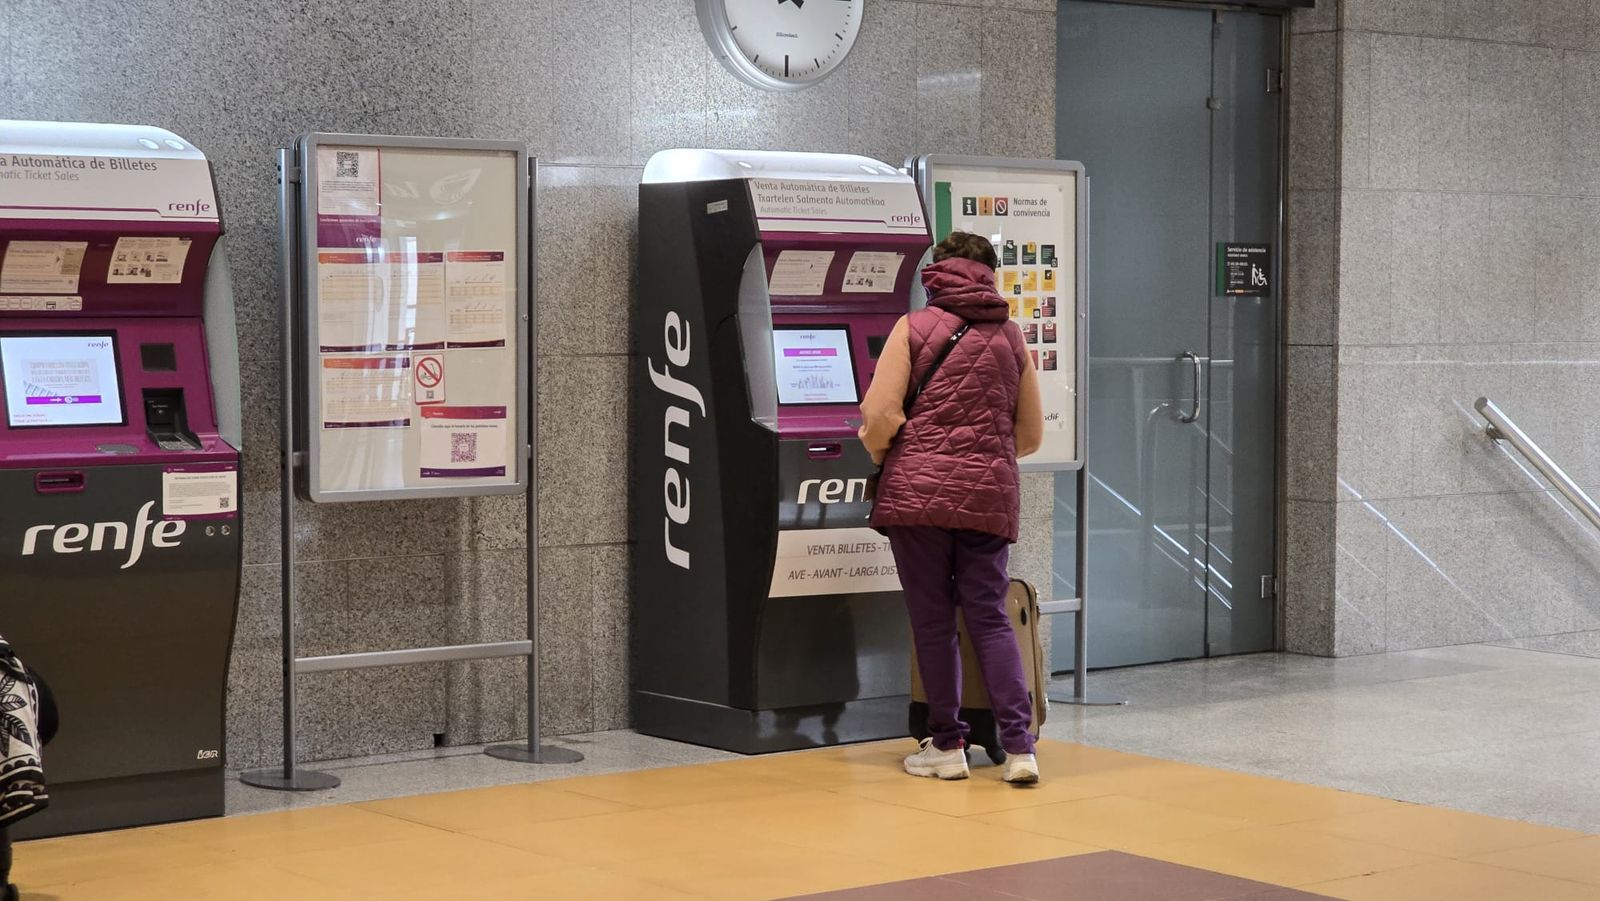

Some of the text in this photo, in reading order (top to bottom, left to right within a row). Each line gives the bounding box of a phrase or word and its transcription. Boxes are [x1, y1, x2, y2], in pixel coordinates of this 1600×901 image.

[12, 155, 86, 169] Automática
[90, 158, 106, 170] de
[110, 159, 158, 172] Billetes
[24, 169, 51, 181] Ticket
[55, 171, 80, 182] Sales
[755, 181, 871, 195] Venta Automática de Billetes
[758, 194, 886, 207] Txartelen Salmenta Automatikoa
[1013, 198, 1048, 206] Normas de
[169, 200, 210, 216] renfe
[793, 206, 811, 215] Ticket
[1013, 209, 1051, 217] convivencia
[891, 213, 921, 225] renfe
[647, 311, 706, 570] renfe
[797, 478, 870, 519] ren
[22, 500, 187, 569] renfe
[807, 545, 836, 555] VENTA
[837, 543, 877, 554] BILLETES
[788, 570, 806, 580] AVE
[813, 568, 843, 578] AVANT
[849, 567, 879, 576] LARGA
